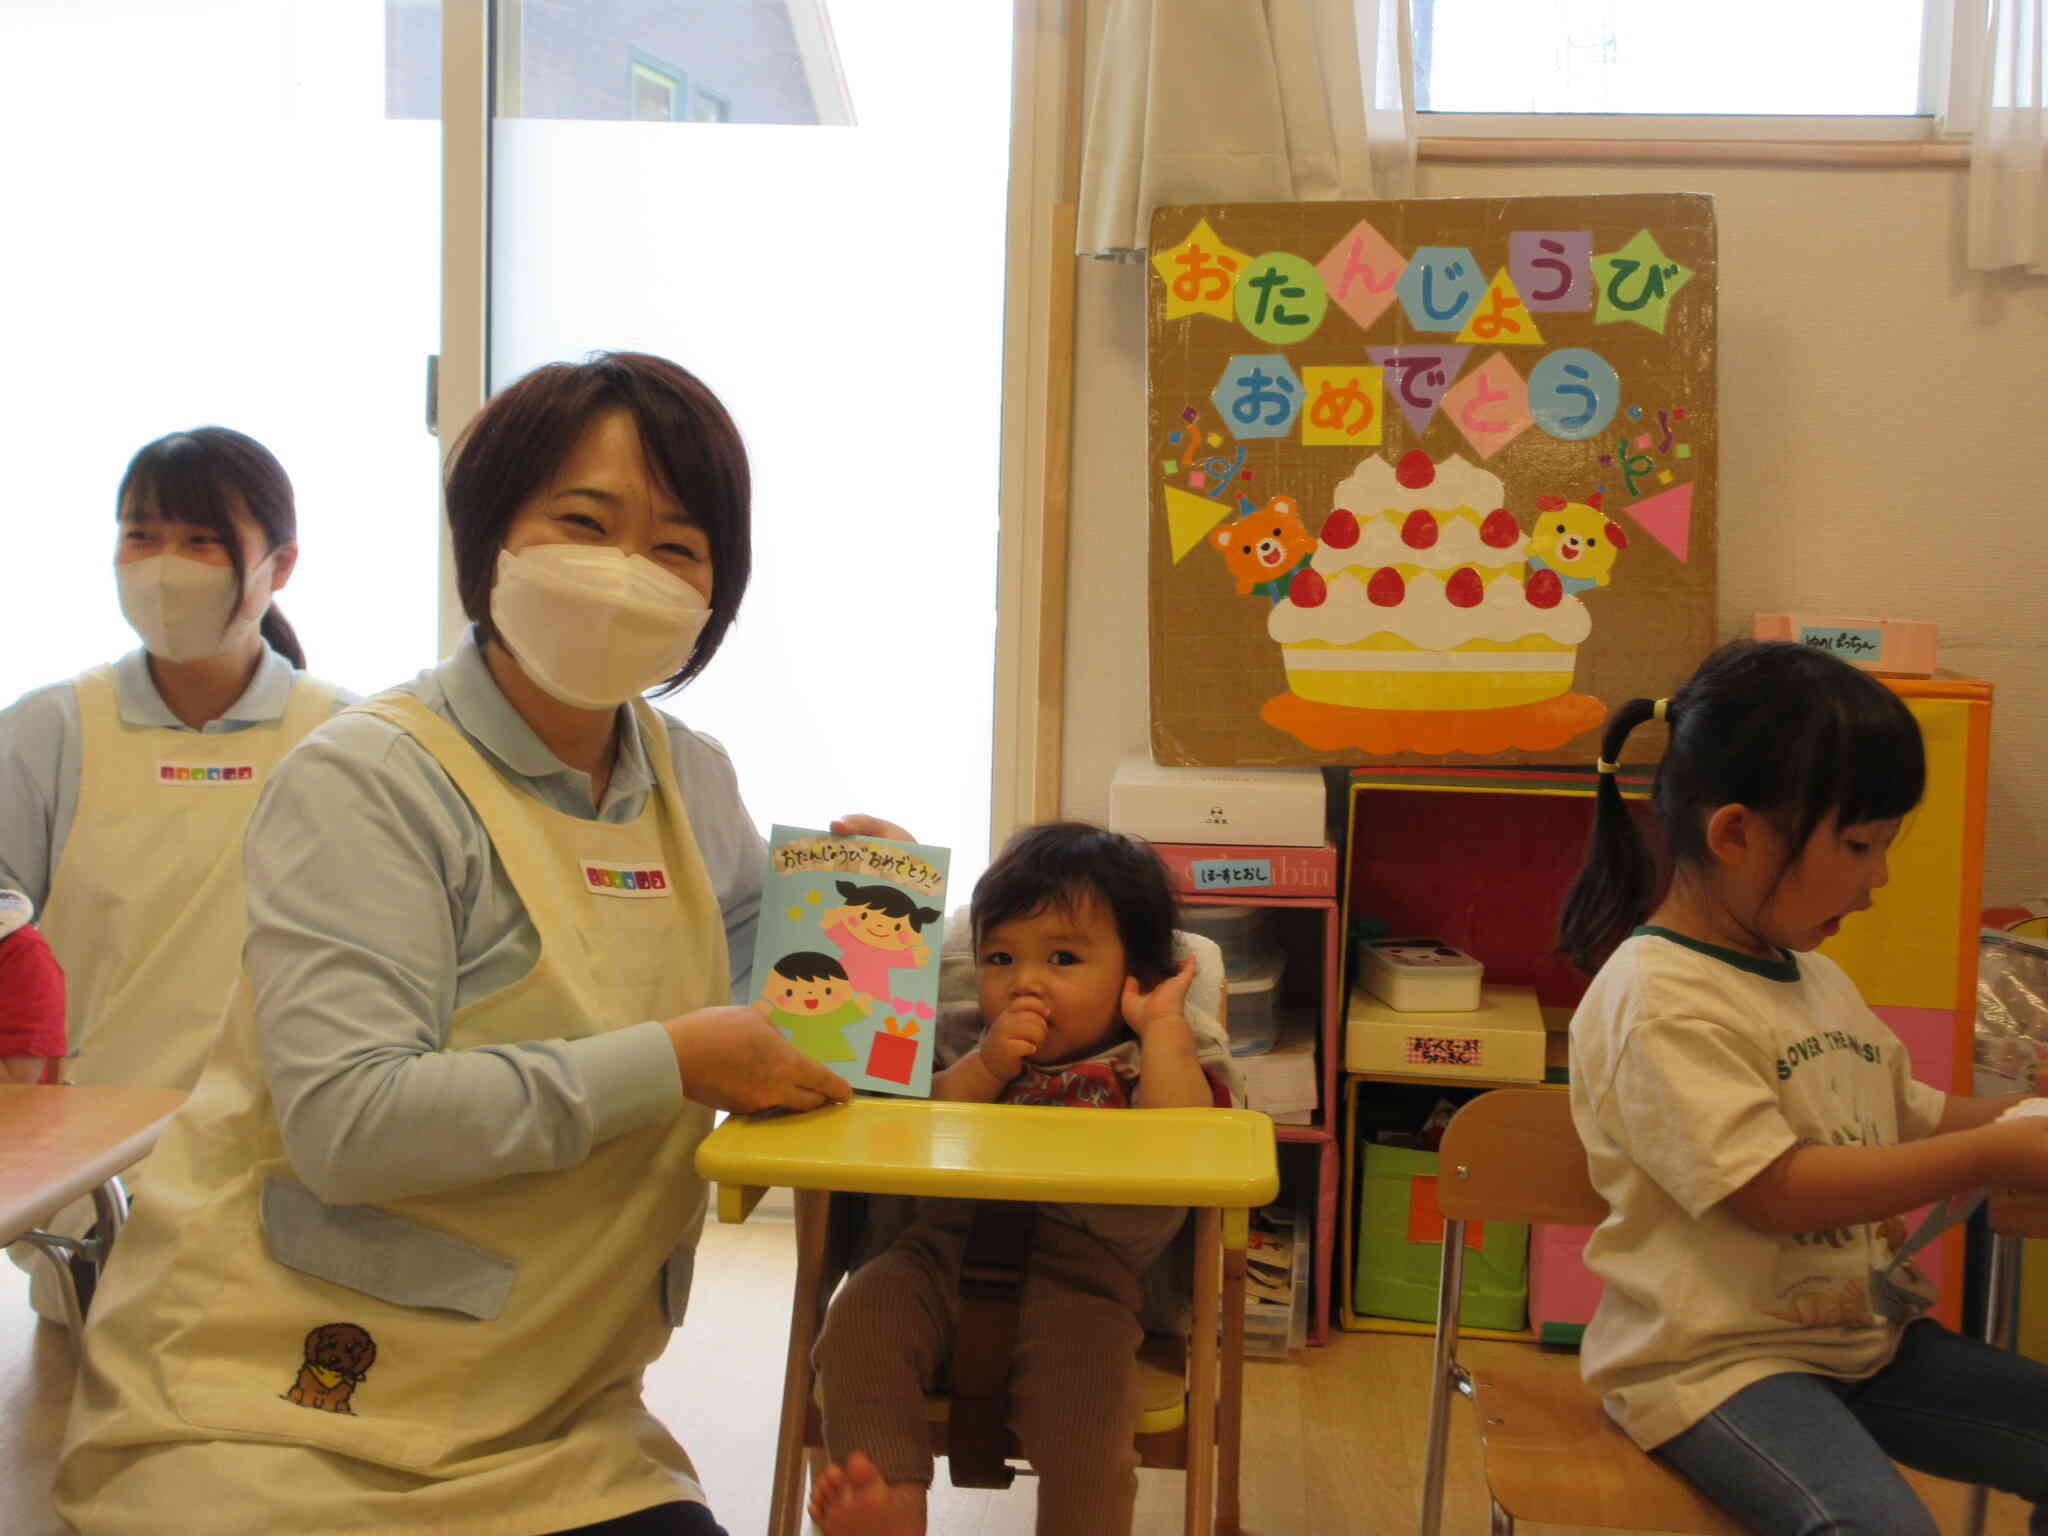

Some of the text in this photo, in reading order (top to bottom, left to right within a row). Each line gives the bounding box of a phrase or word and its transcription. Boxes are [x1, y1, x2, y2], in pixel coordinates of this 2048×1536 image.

[1172, 236, 1679, 341] おたんじょうび
[1231, 356, 1601, 437] おめでとう
